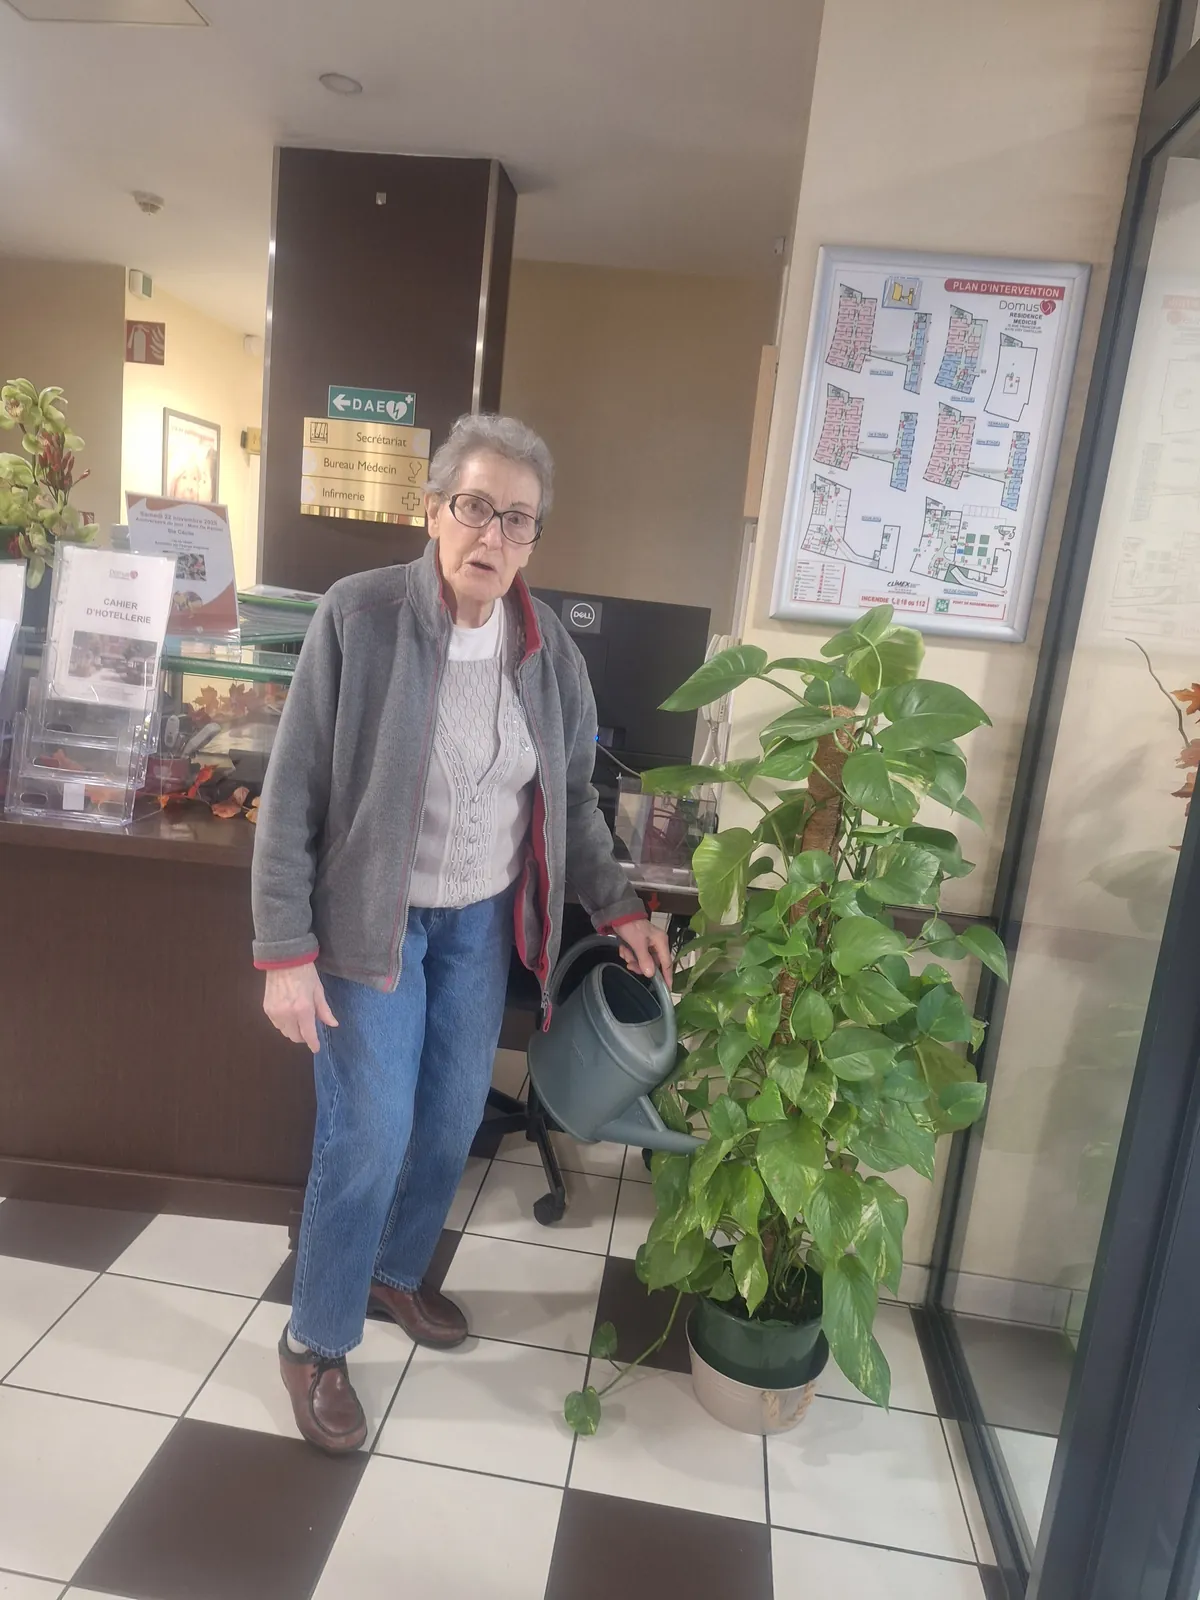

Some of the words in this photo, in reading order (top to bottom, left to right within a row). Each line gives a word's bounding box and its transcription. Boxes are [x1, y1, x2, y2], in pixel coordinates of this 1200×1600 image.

[952, 281, 979, 291] PLAN
[980, 283, 1060, 298] D'INTERVENTION
[999, 300, 1040, 313] Domus
[1009, 312, 1043, 320] RESIDENCE
[352, 398, 385, 413] DAE
[356, 431, 407, 447] Secrétariat
[323, 457, 355, 470] Bureau
[357, 460, 397, 475] Médecin
[322, 487, 365, 501] Infirmerie
[103, 598, 138, 610] CAHIER
[861, 595, 889, 604] INCENDIE
[86, 608, 152, 624] D'HOTELLERIE
[573, 611, 592, 620] DELL
